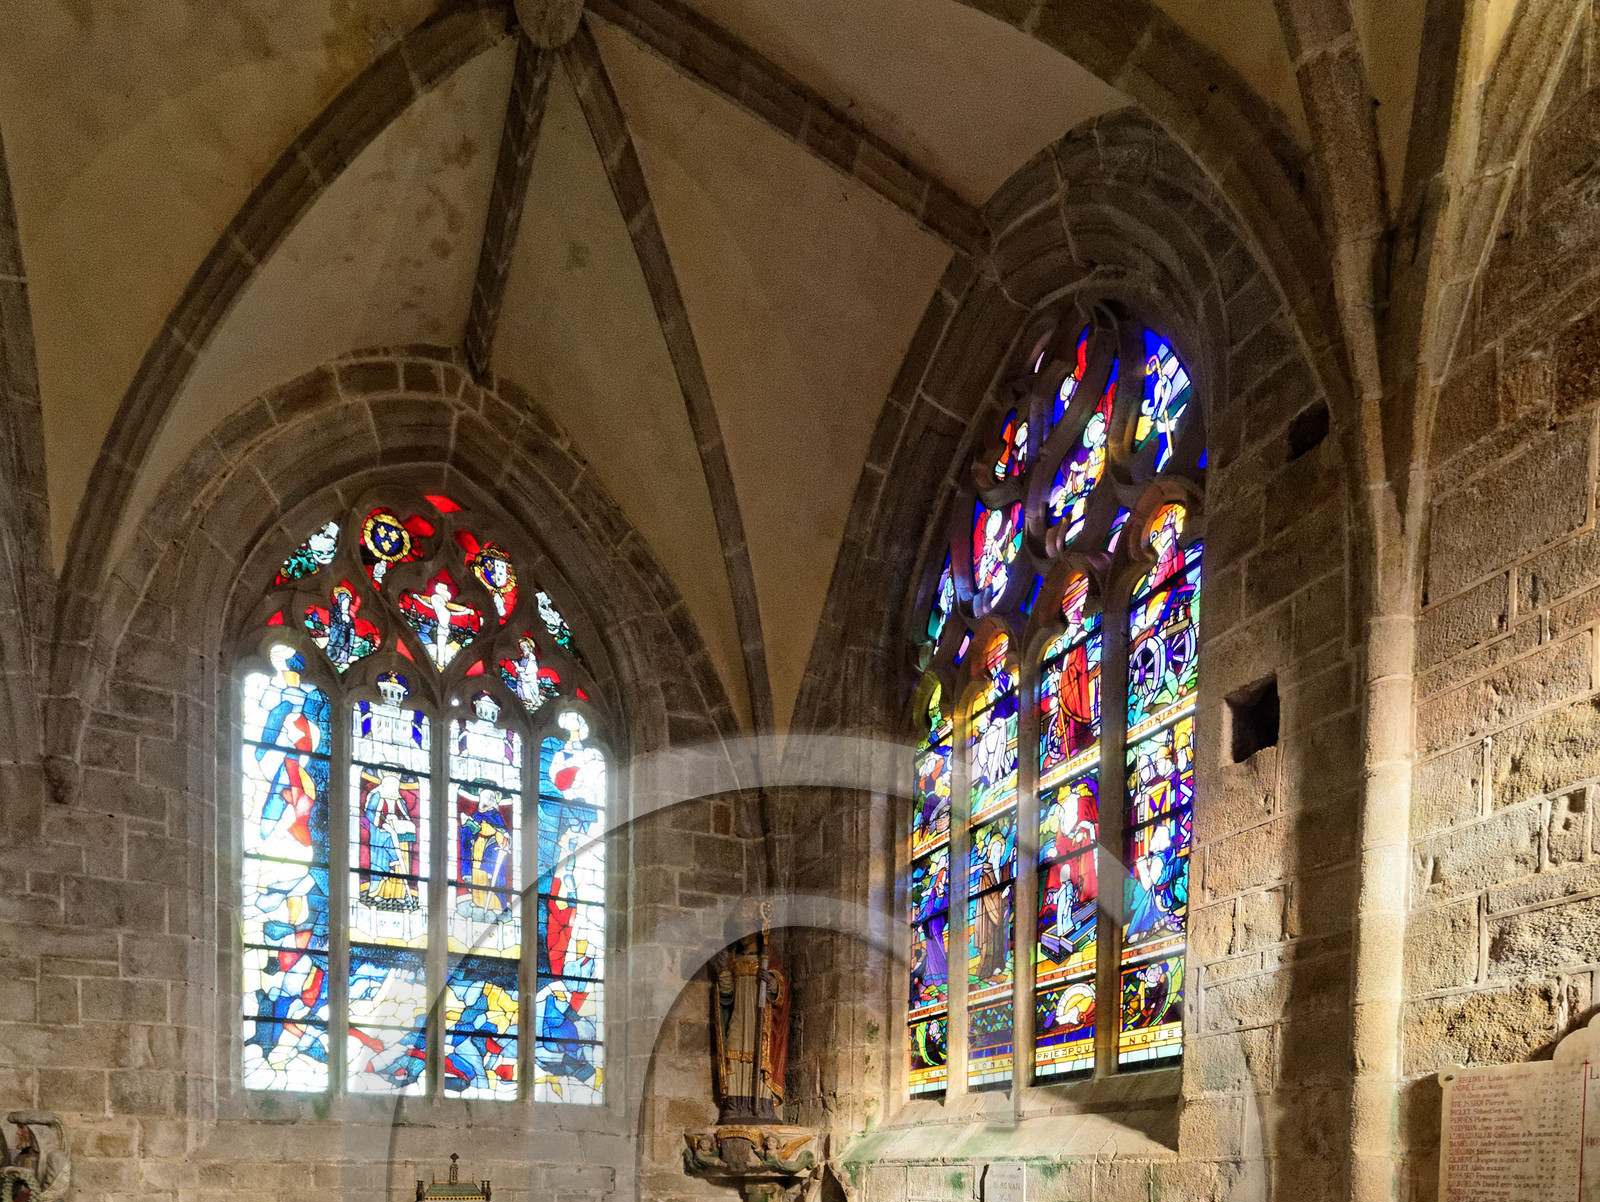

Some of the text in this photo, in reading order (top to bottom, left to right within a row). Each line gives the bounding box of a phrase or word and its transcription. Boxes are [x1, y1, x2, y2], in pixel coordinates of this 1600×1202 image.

[1129, 1029, 1175, 1045] NOUS
[1036, 1044, 1095, 1060] PRIEZ POU
